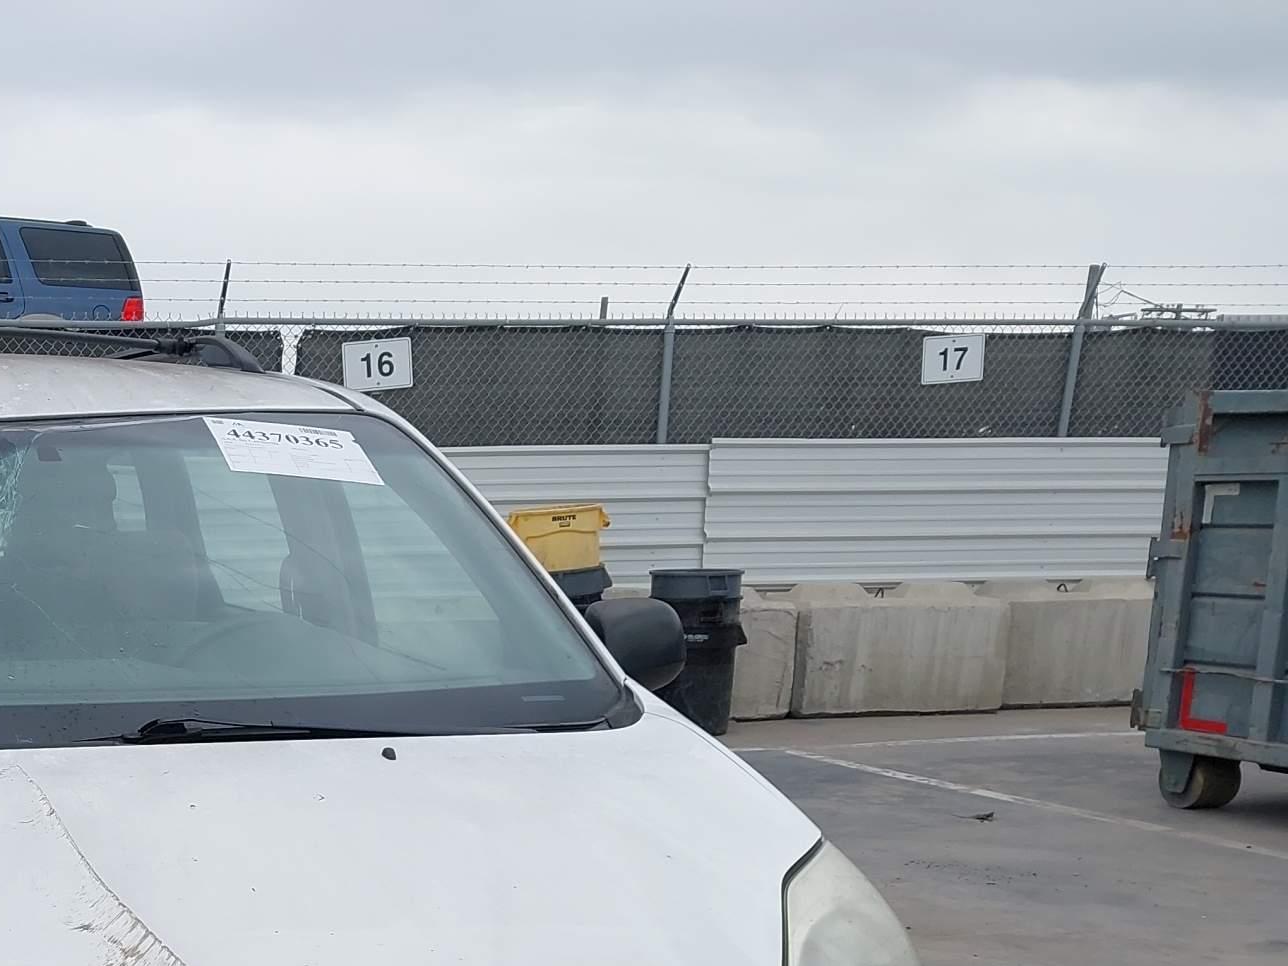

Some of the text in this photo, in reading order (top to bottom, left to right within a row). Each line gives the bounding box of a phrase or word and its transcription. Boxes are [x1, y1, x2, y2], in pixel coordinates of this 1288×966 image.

[360, 351, 395, 378] 16
[938, 346, 969, 371] 17
[226, 428, 344, 450] 44370365
[551, 514, 577, 522] BRUTE
